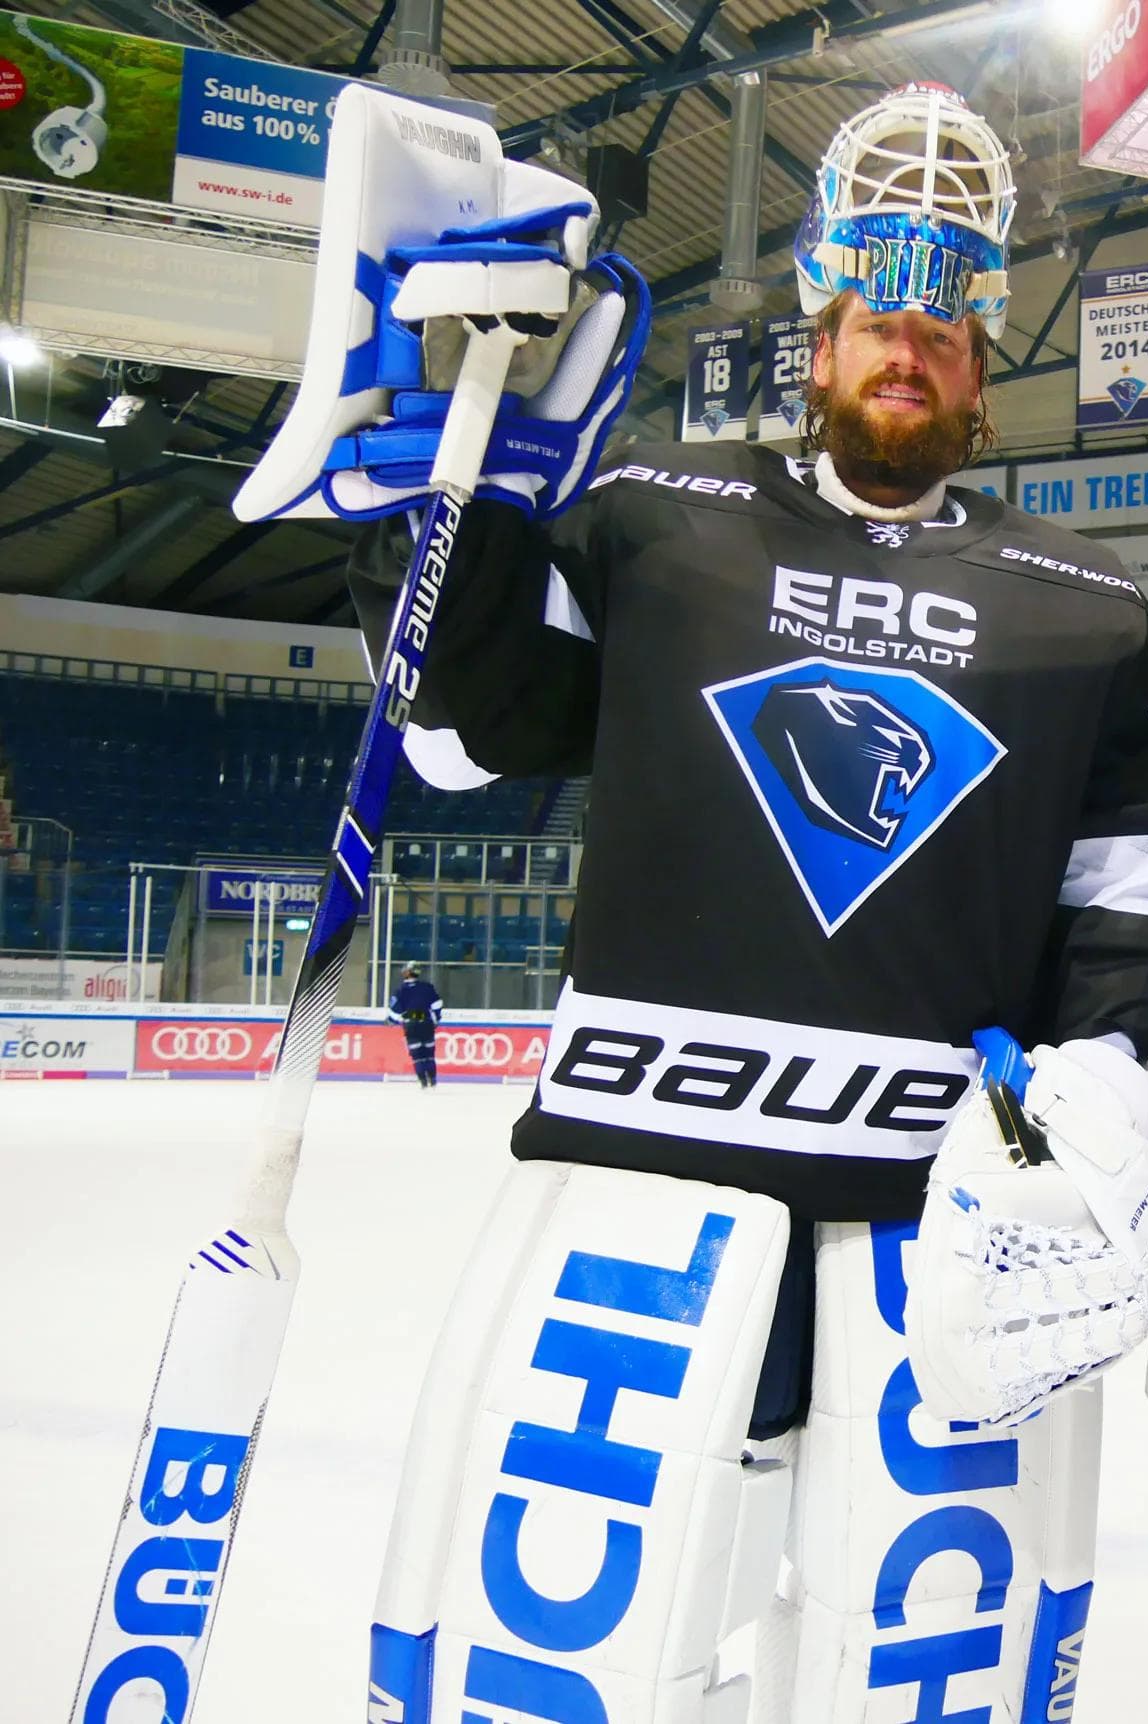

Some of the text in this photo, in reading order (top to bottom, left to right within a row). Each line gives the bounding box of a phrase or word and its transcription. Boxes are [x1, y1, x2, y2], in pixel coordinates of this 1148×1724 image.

[1087, 2, 1142, 82] ERGO
[203, 77, 319, 116] Sauberer
[201, 109, 321, 145] aus 100%
[392, 110, 482, 164] VAUGHN
[198, 181, 294, 206] www.sw-i.de
[707, 344, 729, 359] AST
[777, 332, 810, 349] WAITE
[703, 358, 732, 394] 18
[773, 347, 813, 385] 29
[1023, 478, 1073, 516] EIN
[769, 565, 978, 647] ERC
[296, 648, 307, 665] E
[768, 615, 975, 669] INGOLSTADT
[262, 1031, 363, 1061] Adi
